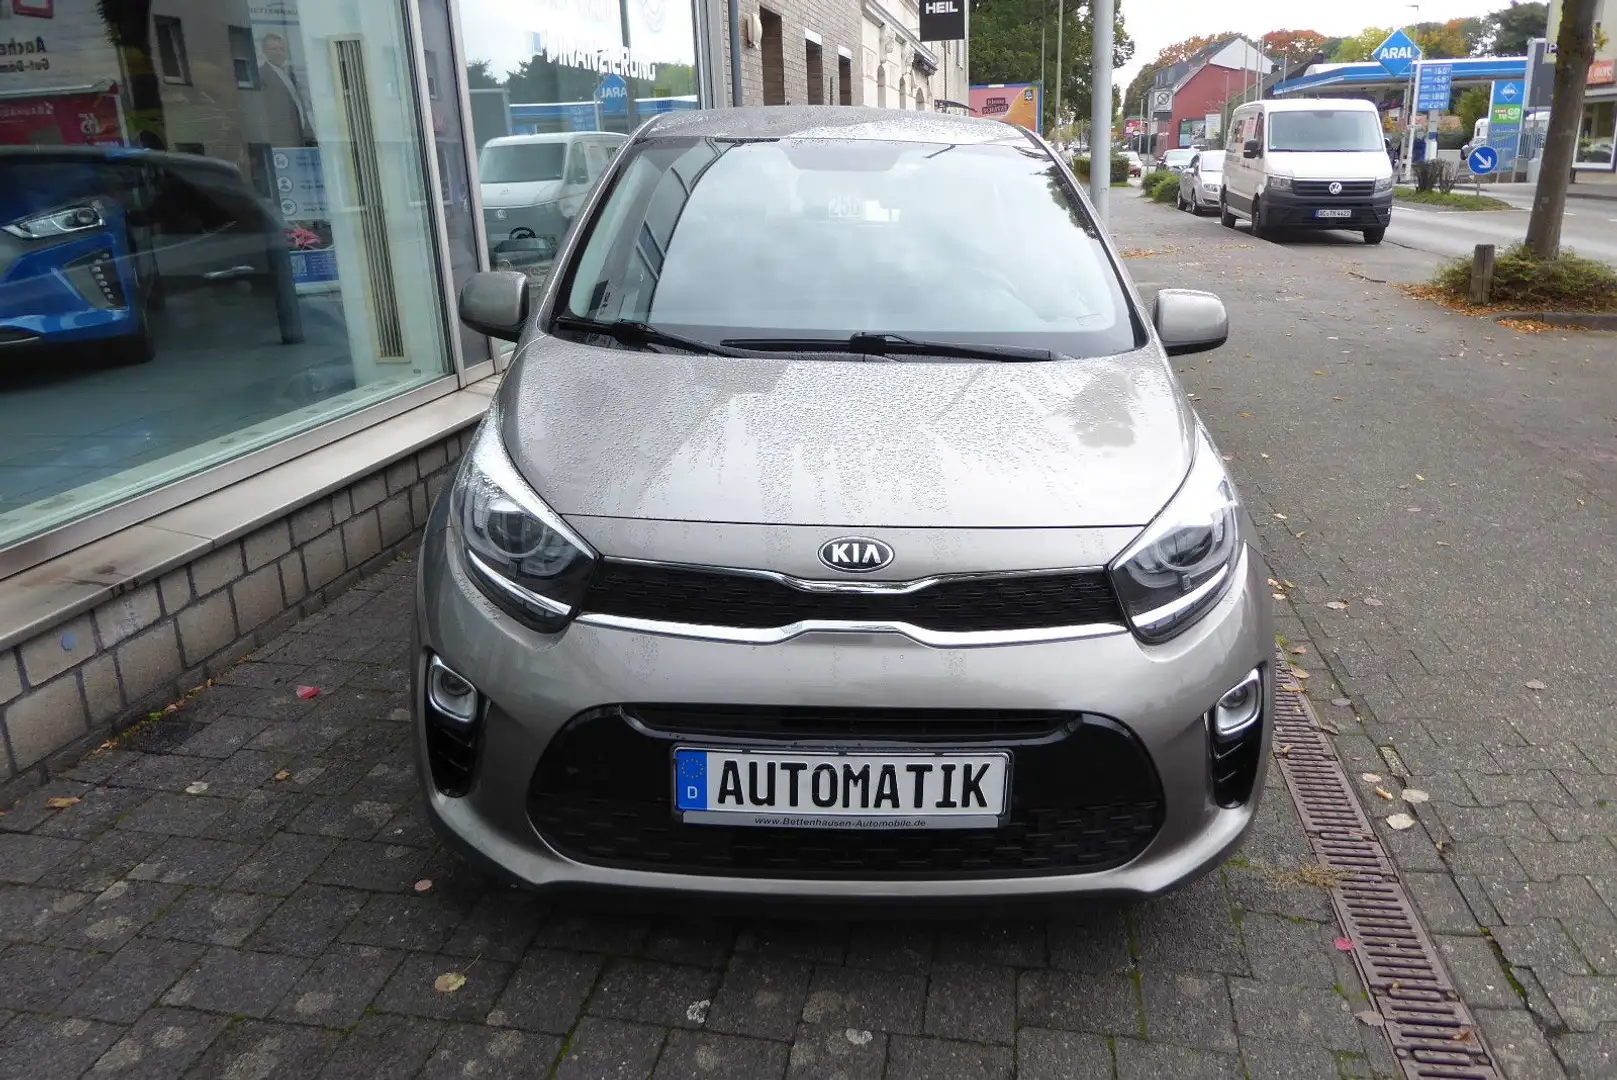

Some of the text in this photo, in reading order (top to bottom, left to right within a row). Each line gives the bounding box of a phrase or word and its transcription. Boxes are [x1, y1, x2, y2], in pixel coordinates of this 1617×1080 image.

[925, 1, 959, 14] HEIL
[1380, 46, 1414, 59] ARAL
[831, 543, 882, 564] KIA
[687, 759, 991, 809] D AUTOMATIK
[754, 817, 927, 829] www.Bettenhausen-Automobile.de
